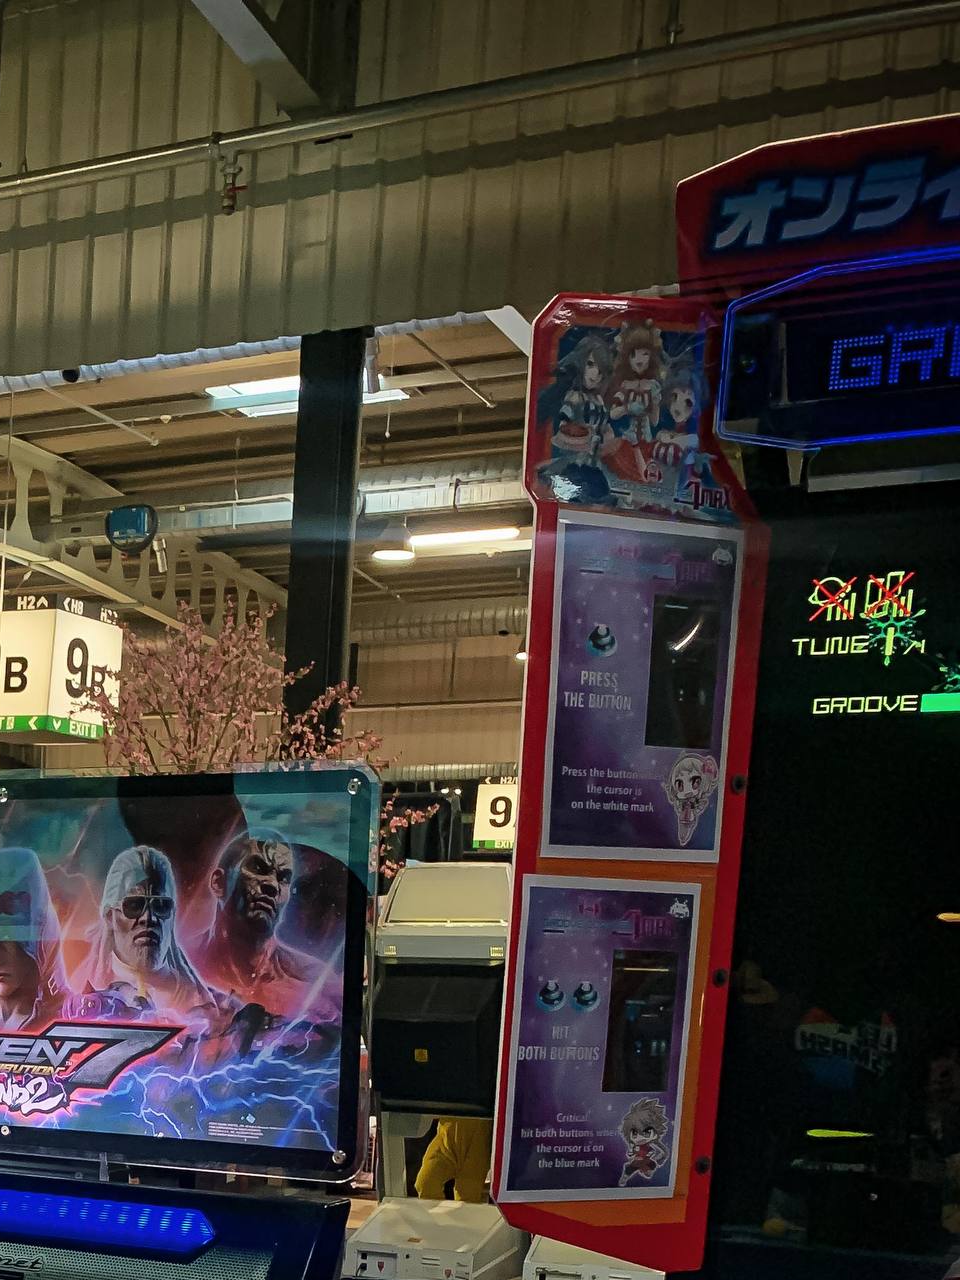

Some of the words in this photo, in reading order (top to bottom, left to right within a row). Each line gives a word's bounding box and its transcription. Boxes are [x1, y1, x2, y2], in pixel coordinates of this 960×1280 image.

[17, 596, 36, 610] H2
[71, 599, 84, 615] H8
[792, 635, 869, 656] TUNE
[581, 670, 618, 689] PRESS
[564, 691, 585, 708] THE
[588, 692, 632, 711] BUTTON
[812, 695, 919, 714] GROOVE
[69, 722, 89, 736] EXIT
[562, 765, 587, 778] Press
[589, 767, 605, 778] the
[607, 768, 638, 780] button
[587, 783, 602, 794] the
[604, 785, 633, 796] cursor
[571, 801, 584, 810] on
[586, 799, 601, 810] the
[603, 800, 629, 812] white
[631, 802, 654, 813] mark
[552, 1025, 570, 1039] HIT
[41, 1024, 174, 1086] 7
[518, 1045, 547, 1061] BOTH
[549, 1046, 600, 1061] BUTTONS
[521, 1128, 533, 1138] hit
[535, 1128, 557, 1138] both
[559, 1128, 594, 1138] buttons
[536, 1143, 552, 1153] the
[553, 1144, 582, 1153] cursor
[538, 1158, 553, 1169] the
[554, 1157, 575, 1168] blue
[577, 1157, 600, 1168] mark
